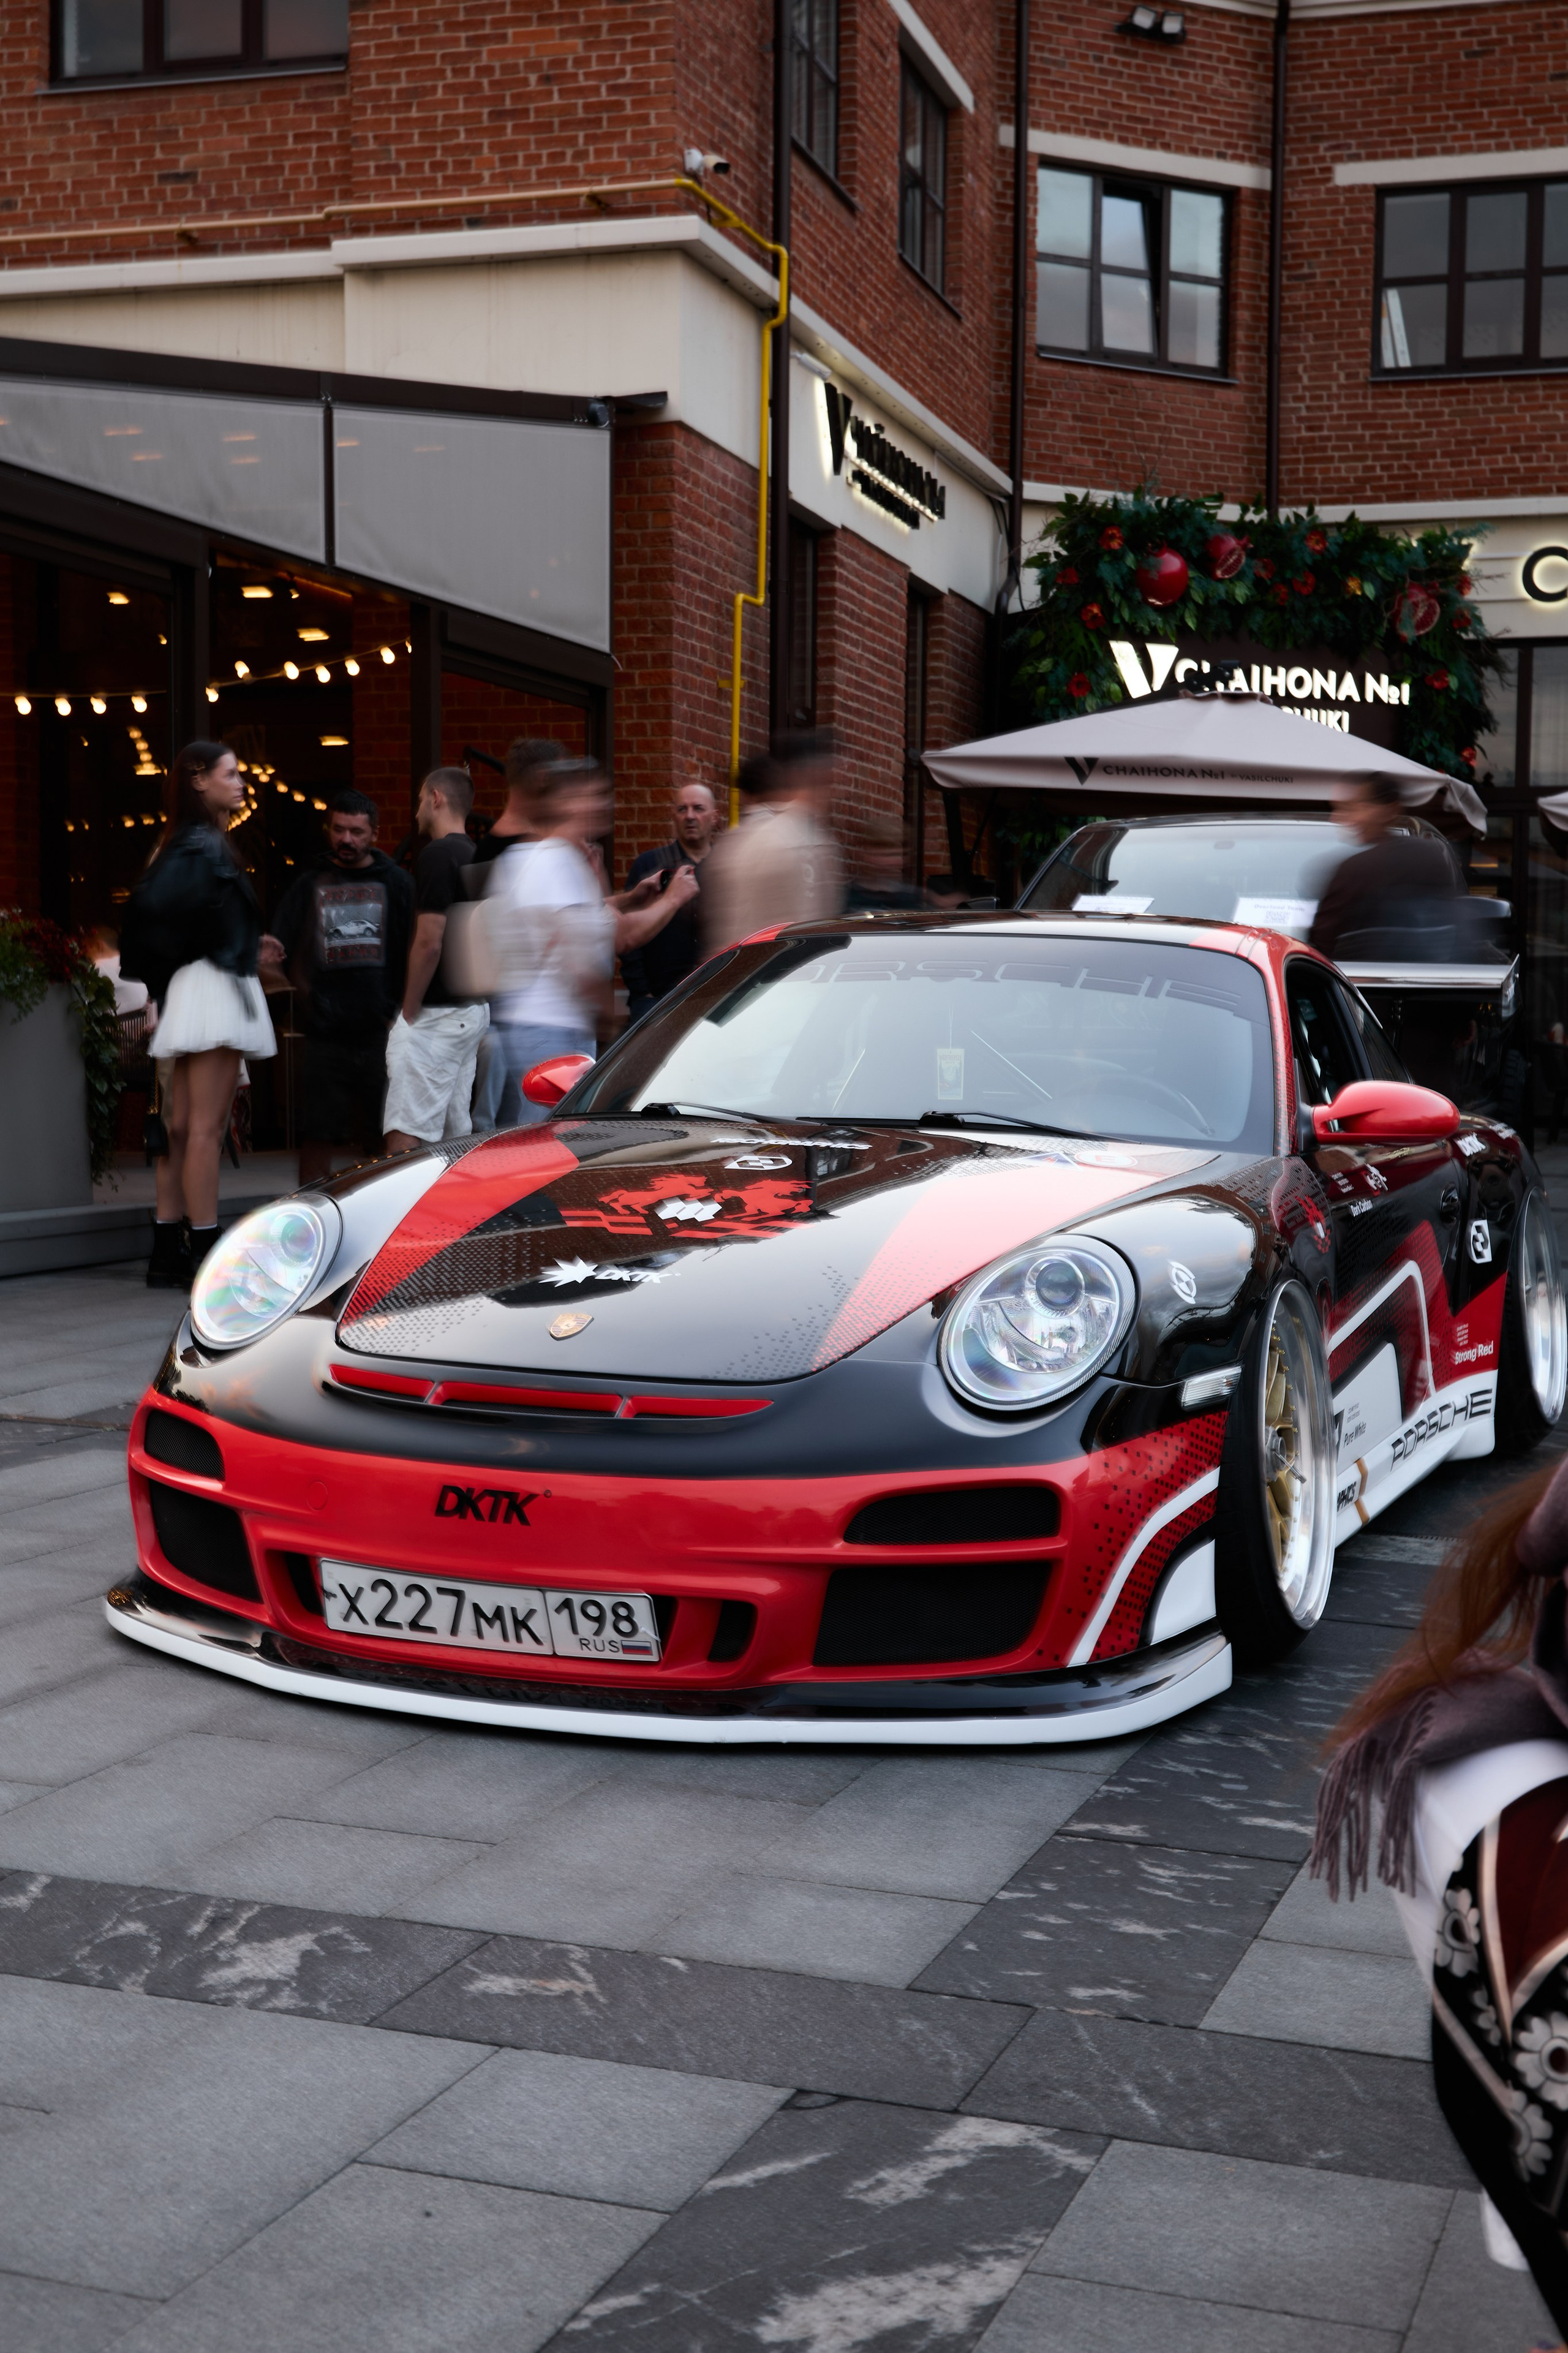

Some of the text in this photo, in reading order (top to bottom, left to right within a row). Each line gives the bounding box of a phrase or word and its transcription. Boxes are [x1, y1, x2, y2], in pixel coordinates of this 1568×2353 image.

[1103, 765, 1196, 779] CHAIHONA
[1238, 773, 1294, 784] VASILCHUKI
[594, 1269, 673, 1283] DKTK
[1455, 1340, 1494, 1365] Strong Red
[1343, 1421, 1366, 1448] Pure White
[1390, 1388, 1493, 1472] PORSCHE
[434, 1484, 540, 1527] DKTK
[554, 1597, 639, 1637] 198
[579, 1637, 620, 1653] RUS
